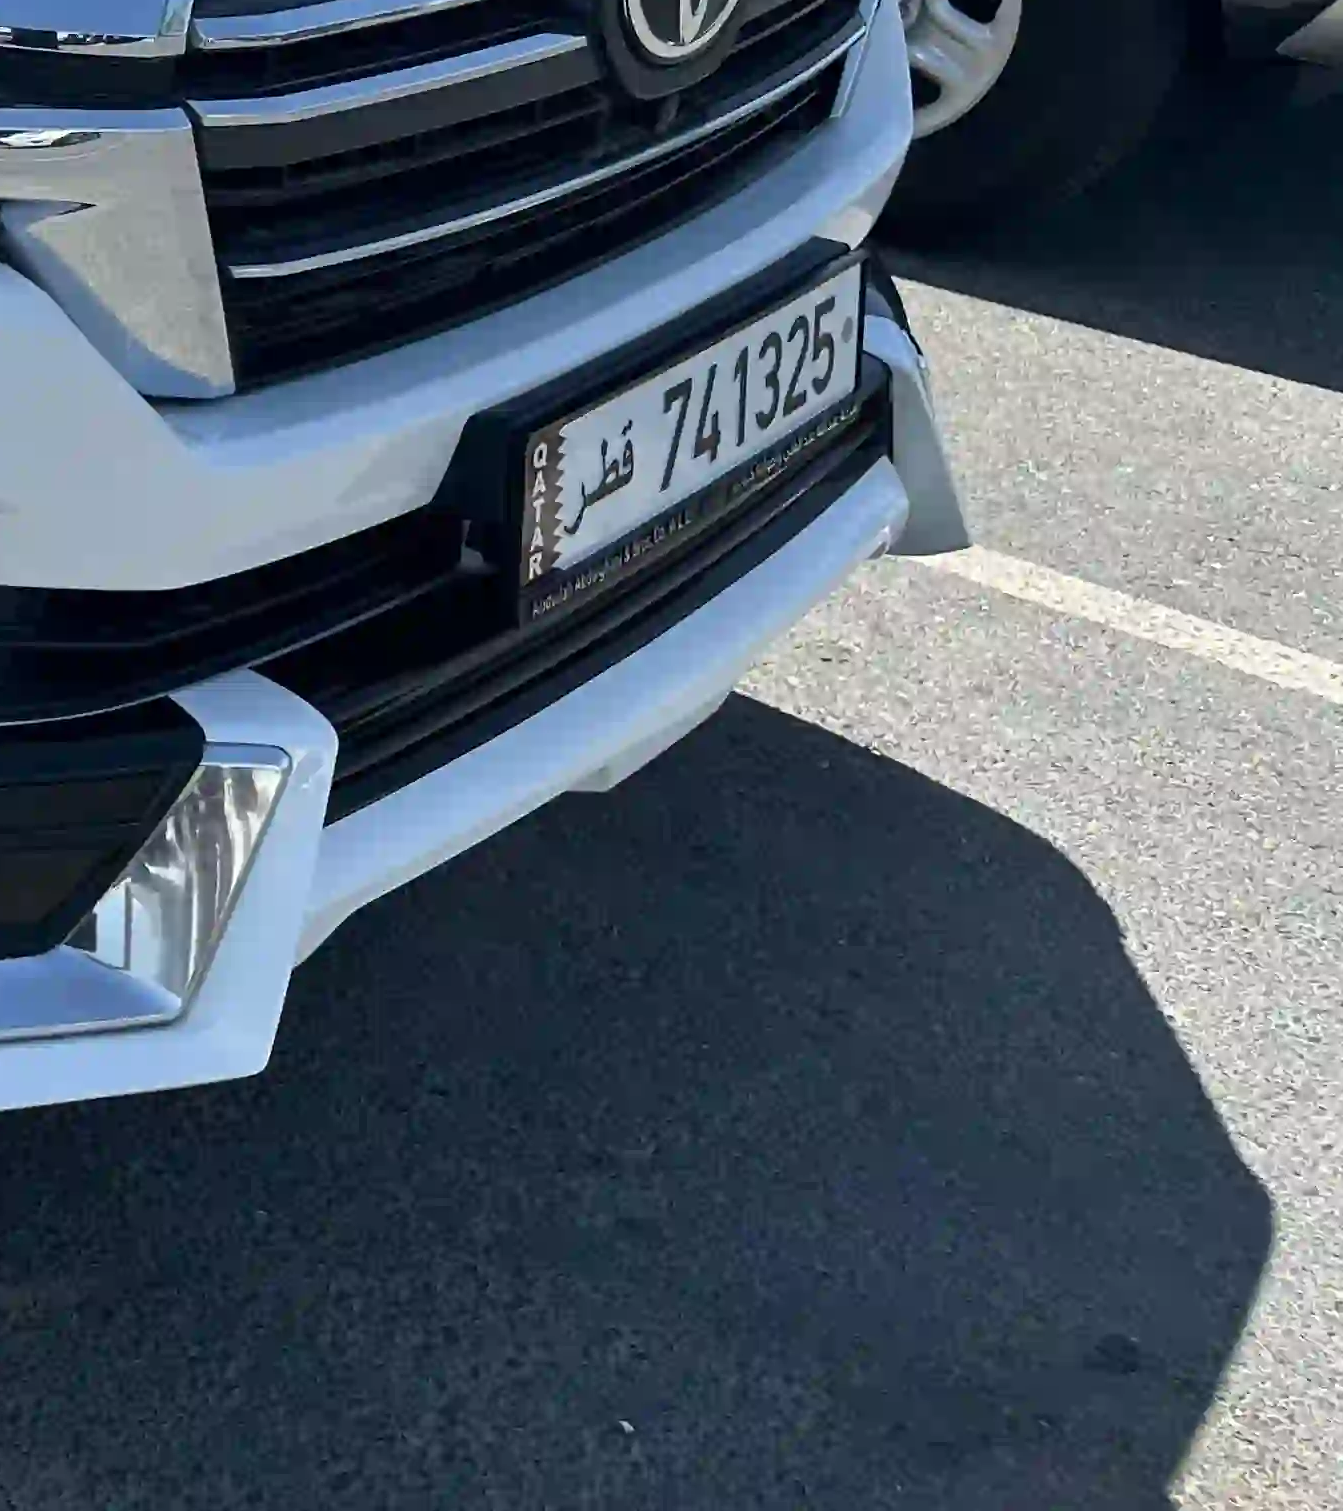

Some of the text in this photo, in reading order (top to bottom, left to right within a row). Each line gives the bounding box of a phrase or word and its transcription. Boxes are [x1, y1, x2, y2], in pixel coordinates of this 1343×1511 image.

[660, 296, 835, 491] 741325
[527, 442, 549, 581] QATAR
[563, 419, 635, 536] قطر
